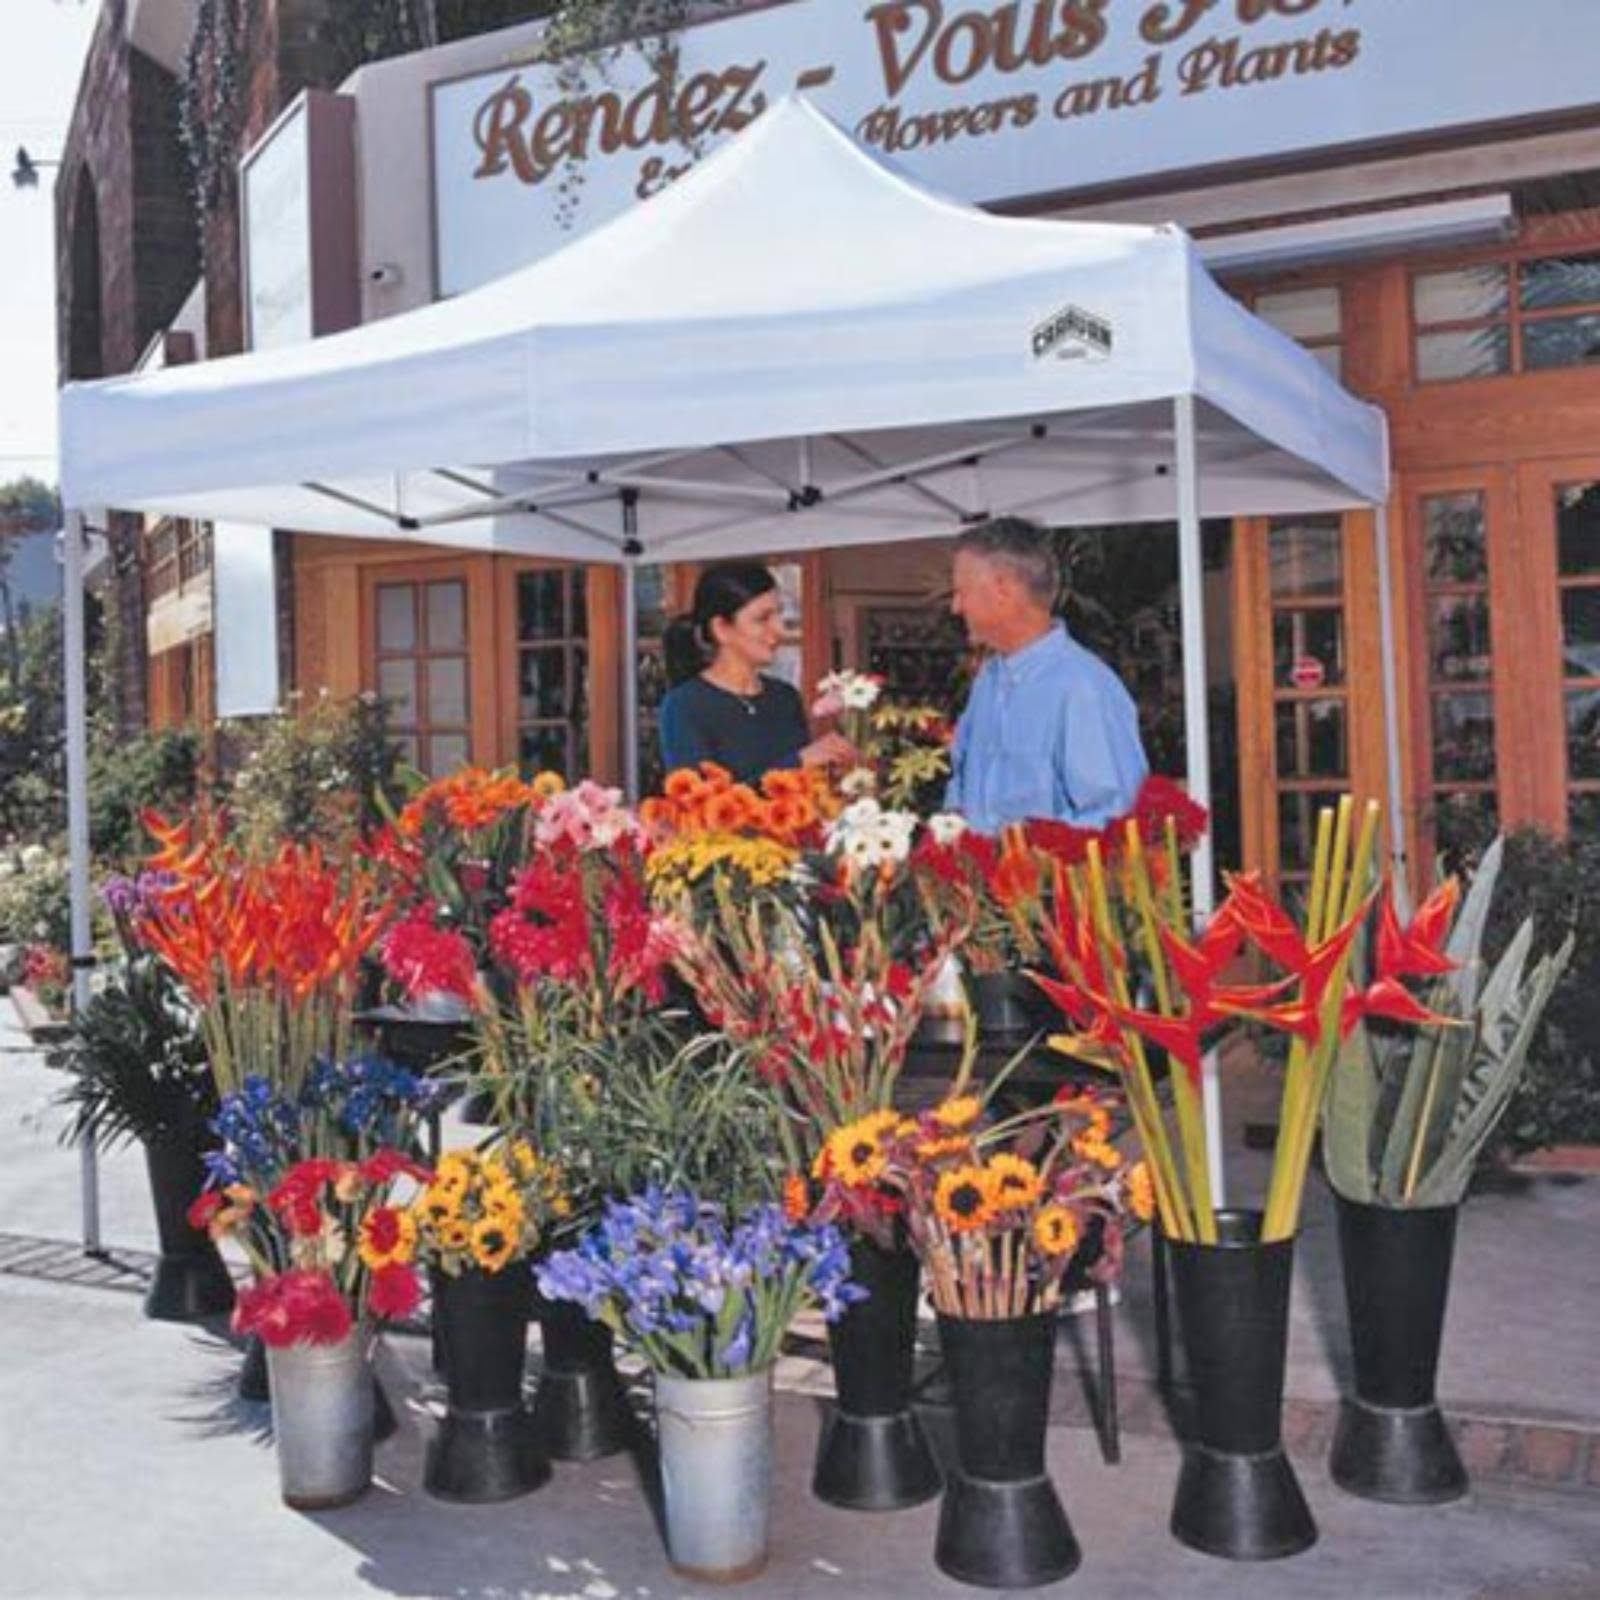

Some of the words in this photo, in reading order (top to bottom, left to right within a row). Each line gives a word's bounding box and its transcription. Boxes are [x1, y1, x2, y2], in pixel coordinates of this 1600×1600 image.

[473, 50, 767, 184] Rendez
[864, 0, 1108, 99] Vous
[854, 92, 1039, 154] Flowers
[1053, 53, 1162, 119] and
[1177, 28, 1361, 96] Plants
